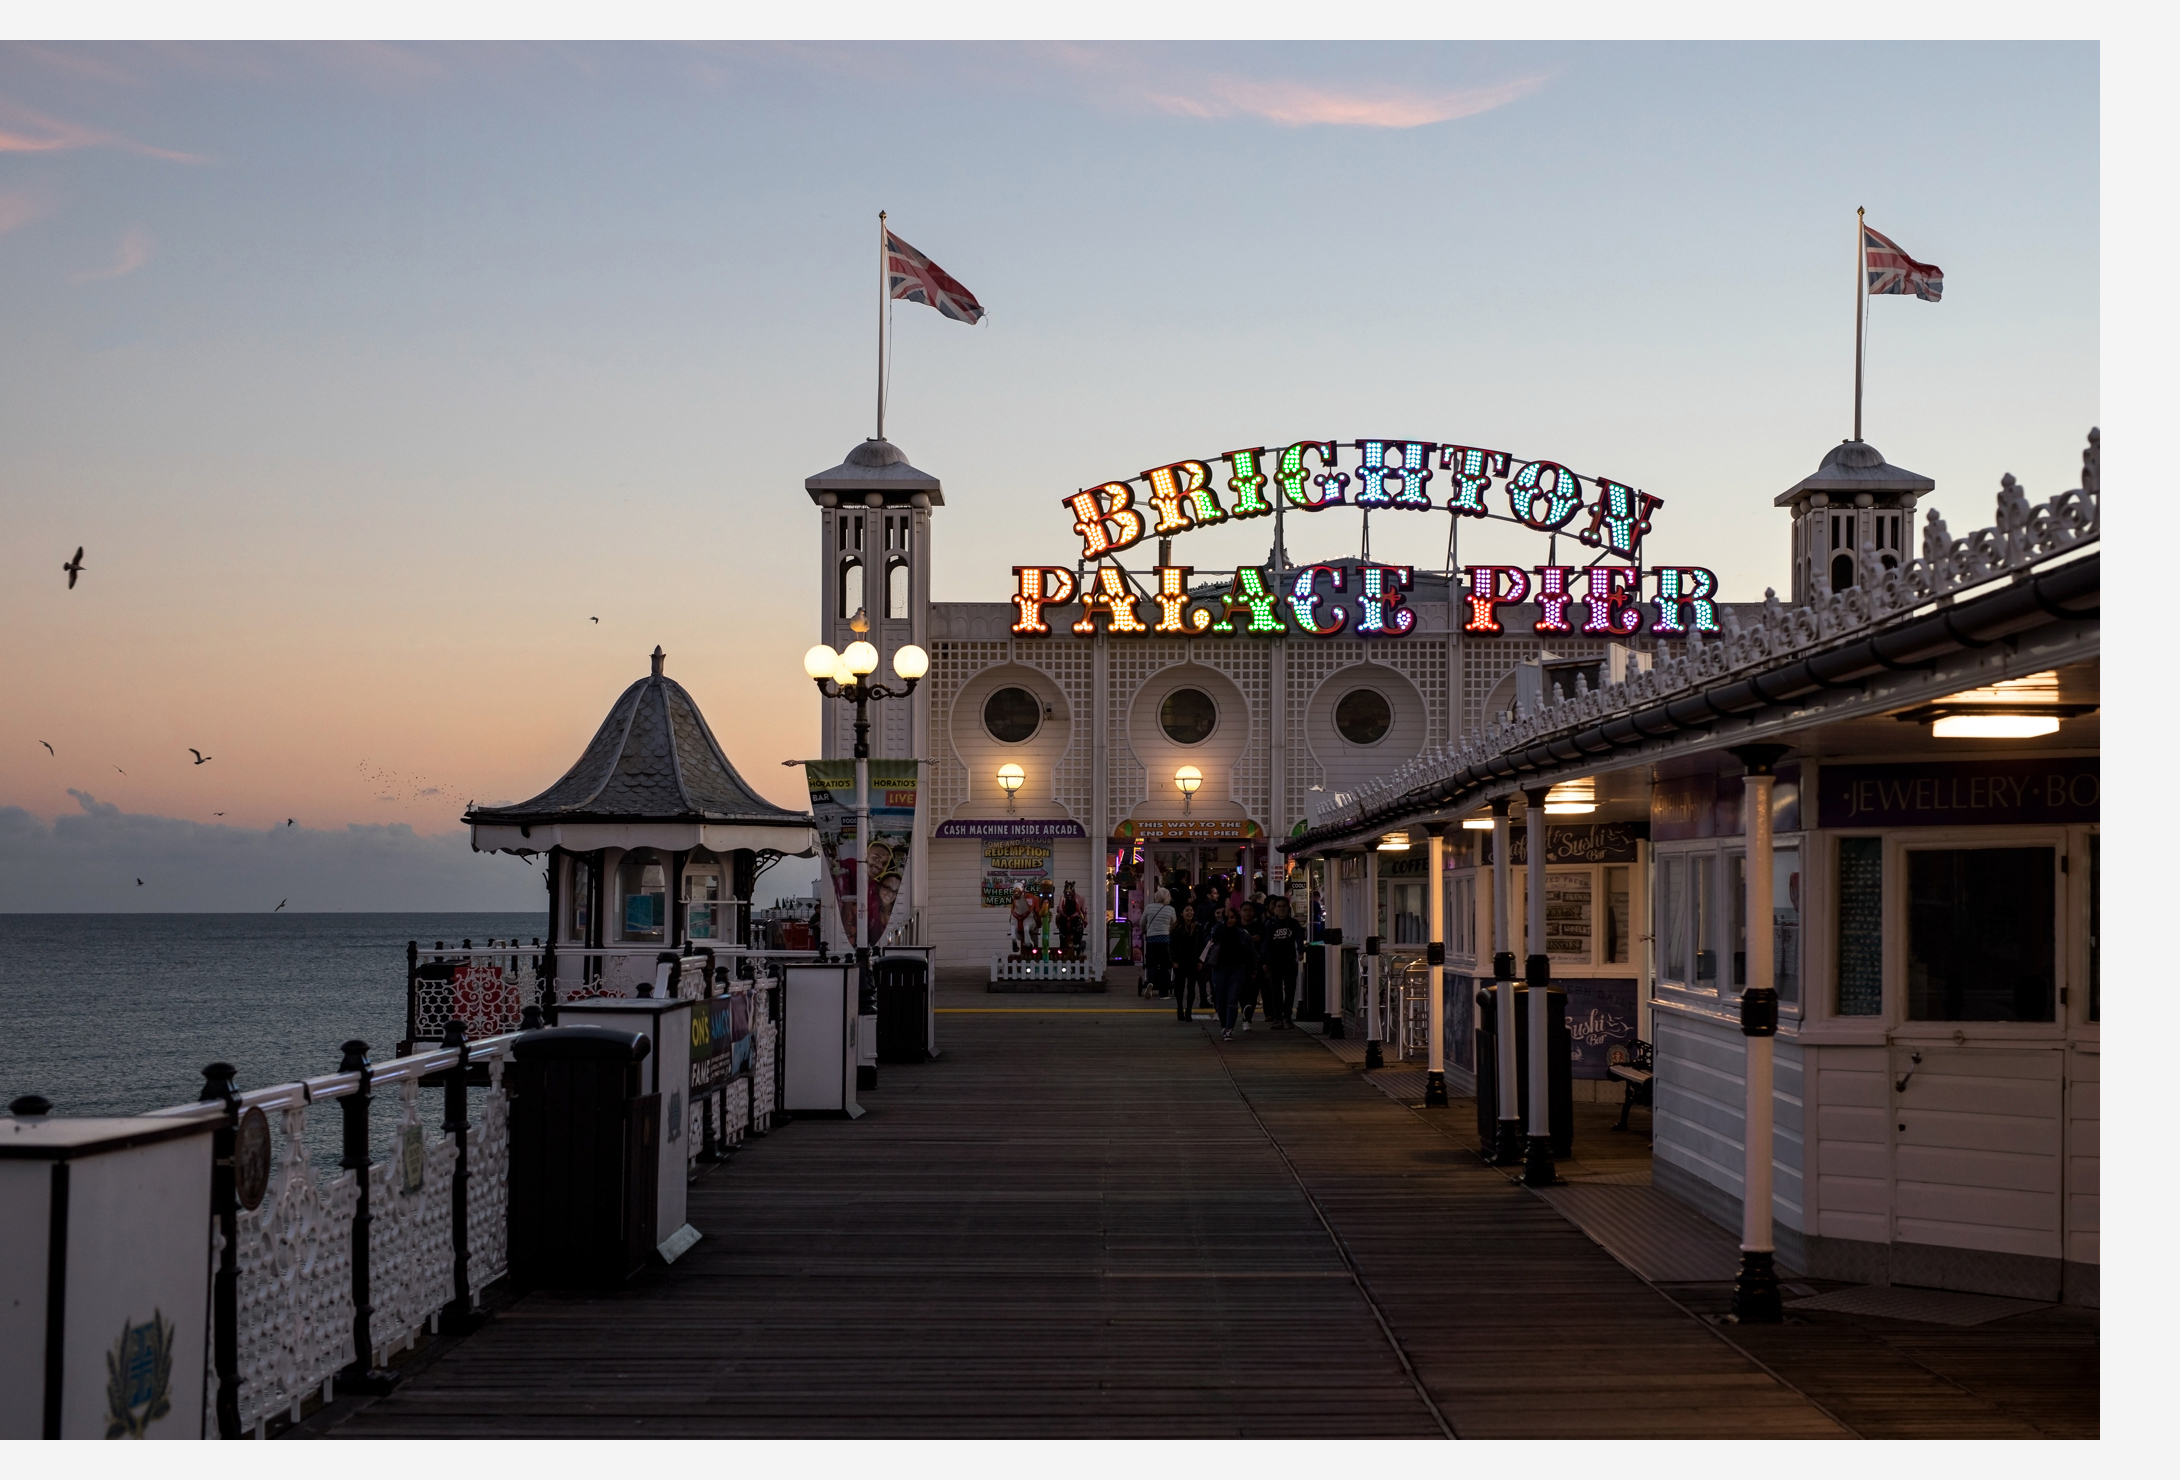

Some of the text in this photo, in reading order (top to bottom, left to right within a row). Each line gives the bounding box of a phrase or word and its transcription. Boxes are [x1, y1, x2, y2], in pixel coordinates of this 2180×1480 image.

[1062, 438, 1665, 562] BRIGHTON
[1010, 564, 1723, 639] PALACE PIER
[809, 780, 851, 788] HORATIO'S
[873, 780, 916, 788] HORATIO'S
[812, 793, 830, 802] BAR
[889, 793, 914, 804] LIVE
[1848, 773, 2100, 817] JEWELLERY BO
[943, 824, 1078, 835] CASH MACHINE INSIDE ARCADE
[1037, 837, 1052, 845] OUR
[1557, 824, 1605, 858] Sushi
[984, 846, 1050, 857] REDEMPTION
[1586, 849, 1607, 862] Bar
[991, 858, 1044, 869] MACHINES
[1391, 857, 1428, 875] COFFE
[983, 887, 1013, 896] WHERE
[986, 896, 1012, 905] MEAN
[1546, 940, 1577, 950] USSELS
[1586, 1034, 1608, 1046] Bar
[691, 1059, 710, 1088] FAME
